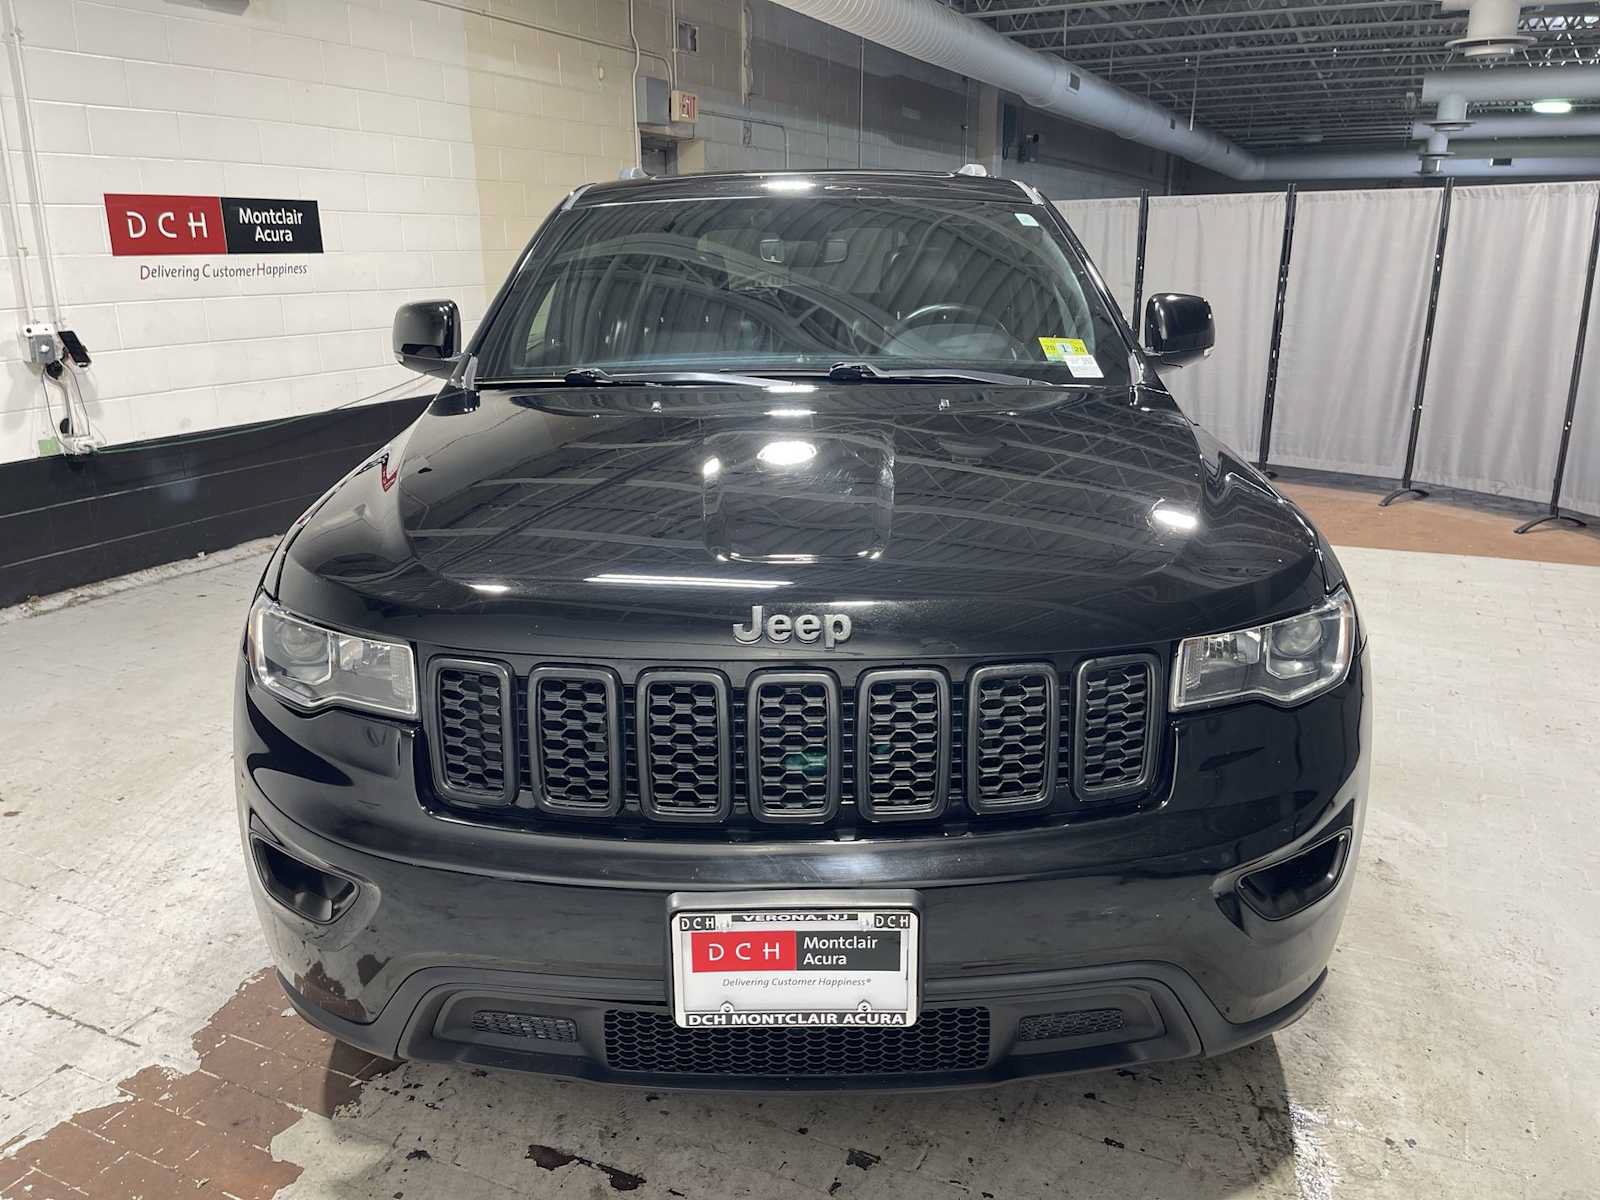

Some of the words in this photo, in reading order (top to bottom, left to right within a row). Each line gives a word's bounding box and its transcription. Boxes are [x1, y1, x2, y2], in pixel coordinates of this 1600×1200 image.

[238, 207, 303, 225] Montclair
[126, 211, 209, 239] DCH
[254, 226, 293, 242] Acura
[140, 264, 200, 282] Delivering
[202, 264, 256, 278] Customer
[256, 263, 308, 278] Happiness
[732, 605, 852, 649] Jeep
[681, 918, 715, 930] DCH
[827, 913, 849, 921] NJ
[875, 915, 909, 928] DCH
[803, 936, 878, 950] Montclair
[708, 942, 780, 961] DCH
[803, 953, 847, 965] Acura
[722, 977, 769, 988] Delivering
[771, 977, 816, 986] Customer
[688, 1013, 726, 1025] DCH
[732, 1013, 837, 1025] MONTCLAIR
[843, 1012, 904, 1025] ACURA
